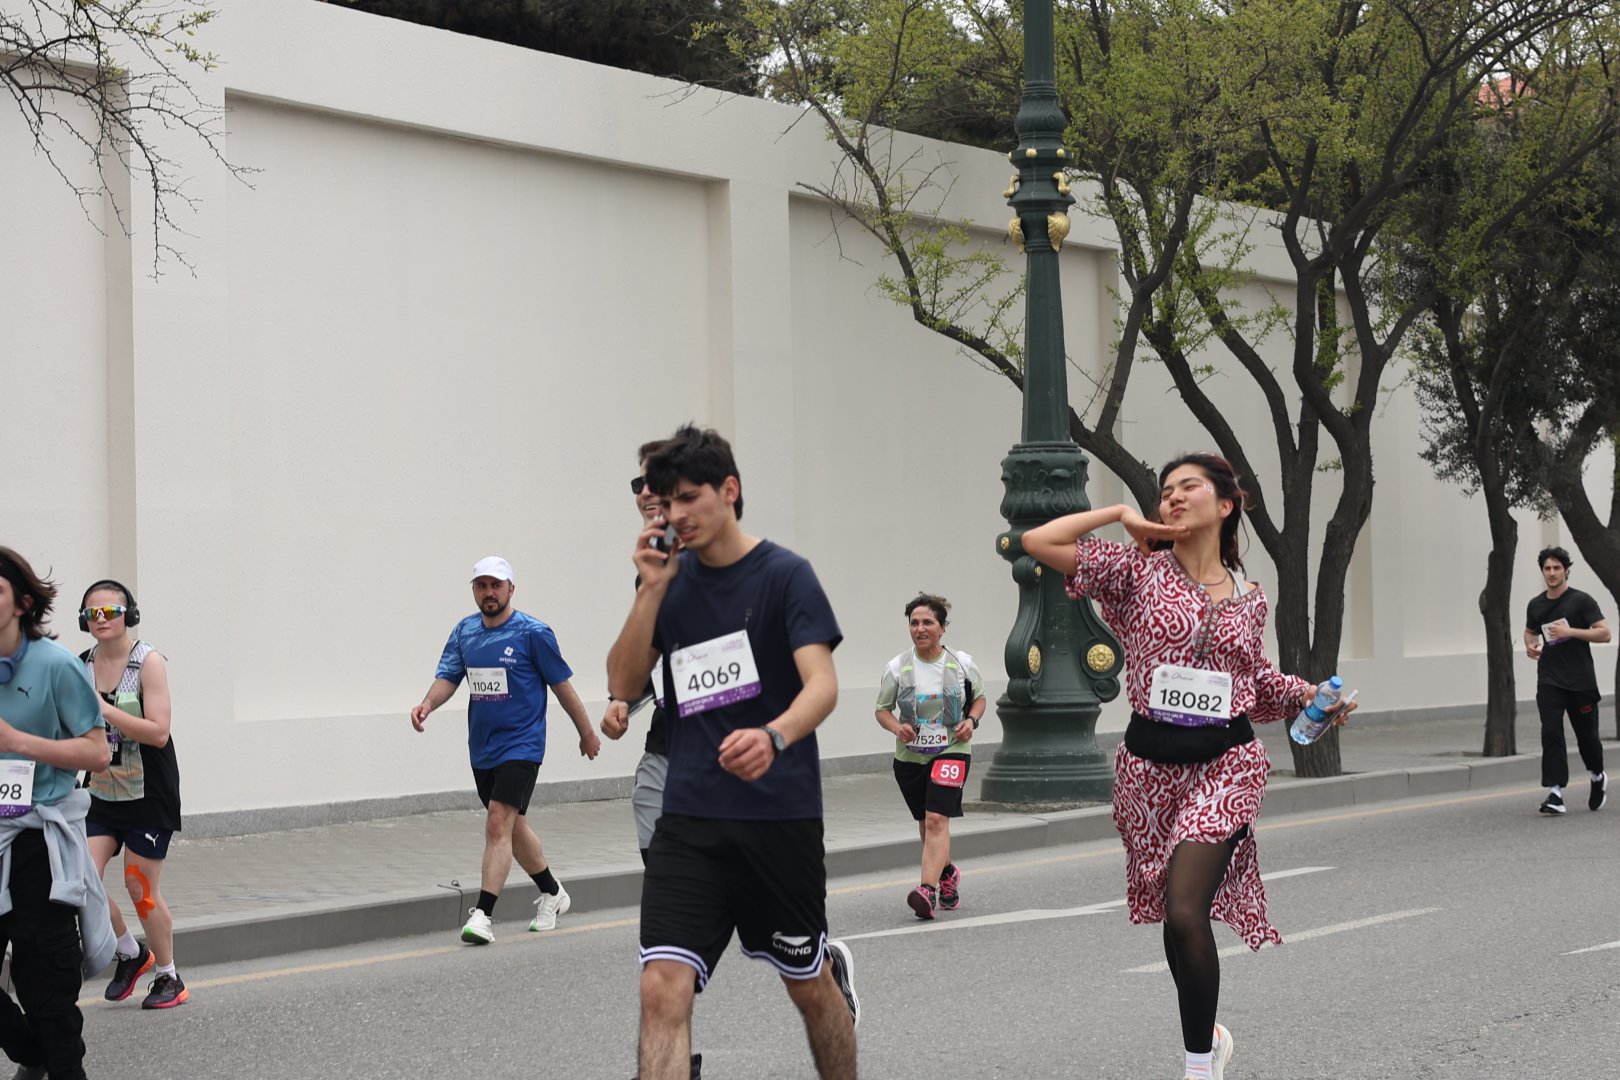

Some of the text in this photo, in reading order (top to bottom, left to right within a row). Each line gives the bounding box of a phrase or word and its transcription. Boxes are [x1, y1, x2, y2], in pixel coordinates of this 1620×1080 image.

[688, 662, 741, 691] 4069
[473, 681, 501, 692] 11042
[1160, 689, 1222, 712] 18082
[940, 764, 960, 780] 59
